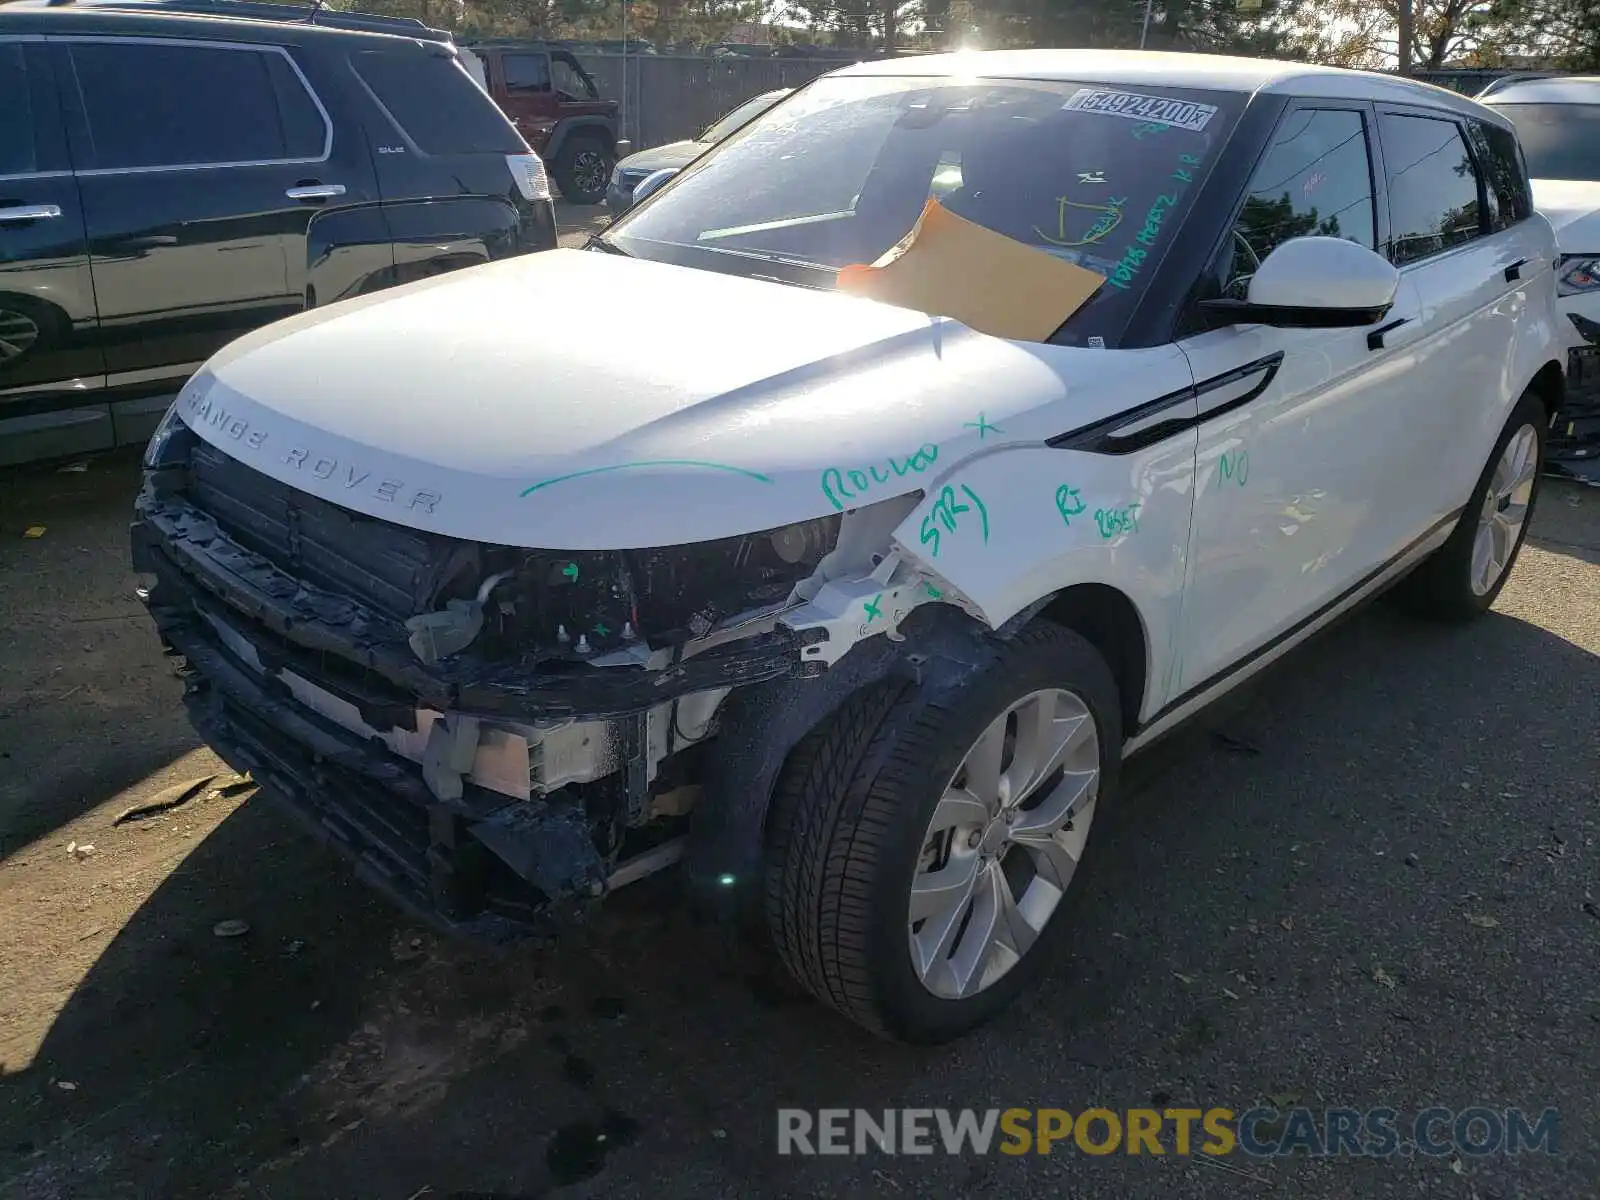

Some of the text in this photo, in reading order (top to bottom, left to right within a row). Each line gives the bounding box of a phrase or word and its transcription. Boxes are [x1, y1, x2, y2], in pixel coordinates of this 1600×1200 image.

[188, 392, 443, 515] RANGE ROVER
[1217, 450, 1250, 488] NO
